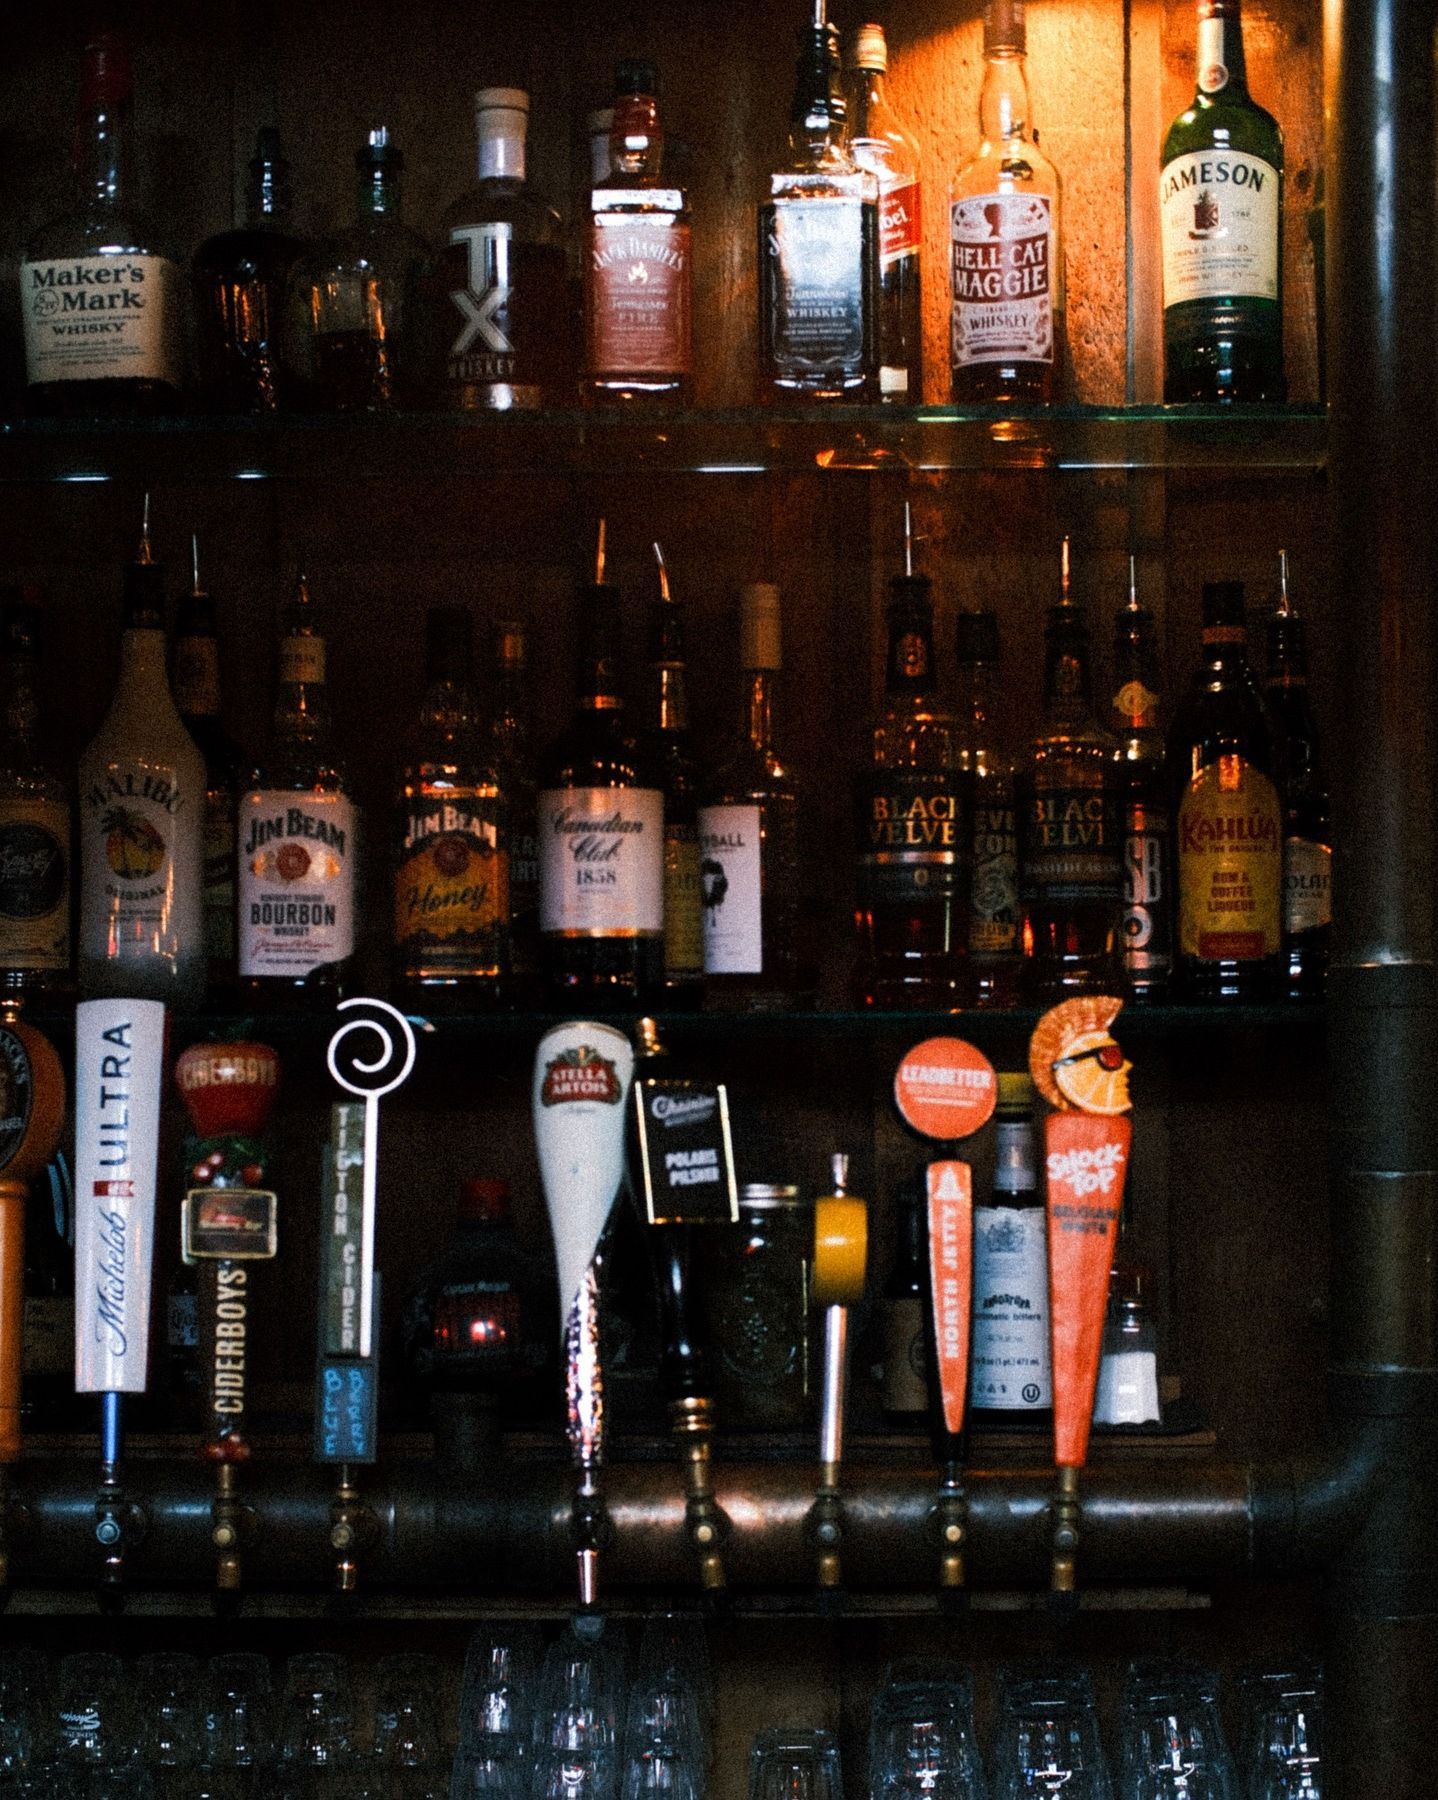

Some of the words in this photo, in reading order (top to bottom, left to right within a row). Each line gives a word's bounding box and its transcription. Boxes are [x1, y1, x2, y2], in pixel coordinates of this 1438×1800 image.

[1162, 161, 1266, 204] JAMESON
[32, 263, 144, 289] Maker's
[954, 263, 1046, 299] MAGGIE
[61, 288, 144, 313] Mark
[786, 306, 849, 319] WHISKEY
[52, 322, 126, 336] WHISKY
[969, 313, 1029, 332] WHISKEY
[246, 816, 284, 856] JIM
[286, 807, 346, 858] BEAM
[404, 812, 440, 849] JIM
[442, 804, 498, 849] BEAM
[552, 808, 644, 835] Canadian
[1182, 807, 1279, 856] KAHLÚA
[569, 834, 624, 863] Club
[703, 833, 746, 848] BALL
[576, 868, 617, 886] 1858
[407, 883, 488, 914] Honey
[250, 903, 336, 927] BOURBON
[552, 1067, 608, 1082] STELLA
[552, 1080, 609, 1096] ARTOIS
[100, 1022, 132, 1167] ULTRA
[669, 1166, 720, 1187] PILSNER
[942, 1203, 959, 1271] JETTY
[96, 1211, 128, 1357] Michelob
[943, 1278, 960, 1359] NORTH
[214, 1269, 247, 1414] CIDERBOYS
